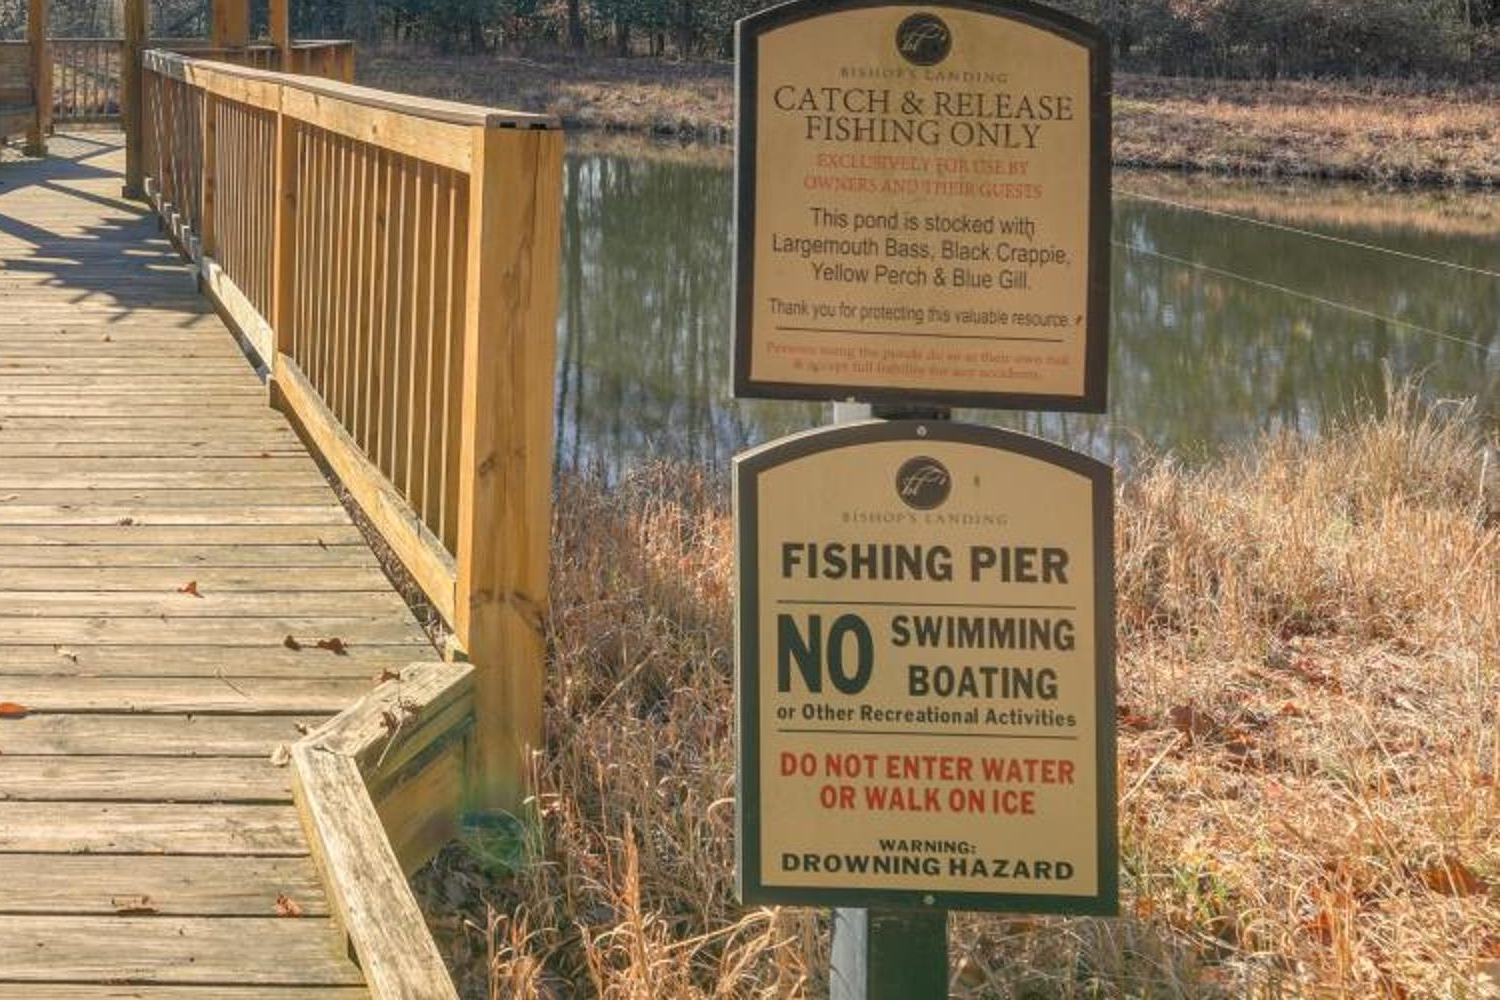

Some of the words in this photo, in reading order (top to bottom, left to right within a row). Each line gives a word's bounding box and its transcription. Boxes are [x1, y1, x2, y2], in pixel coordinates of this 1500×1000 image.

[924, 69, 1009, 83] LANDING
[773, 85, 896, 115] CATCH
[901, 90, 924, 116] &
[934, 91, 1074, 121] RELEASE
[804, 116, 940, 146] FISHING
[950, 122, 1042, 149] ONLY
[818, 153, 930, 172] EXCLUSIVELY
[936, 157, 969, 174] FOR
[973, 159, 1007, 174] USE
[1009, 160, 1029, 175] BY
[803, 175, 877, 194] OWNERS
[881, 179, 919, 195] AND
[923, 180, 975, 197] THEIR
[979, 182, 1043, 200] GUESTS
[810, 207, 848, 229] This
[853, 211, 898, 233] pond
[903, 213, 918, 230] is
[925, 215, 995, 235] stocked
[1000, 217, 1035, 237] with
[772, 233, 879, 258] Largemouth
[885, 238, 935, 260] Bass,
[941, 240, 990, 262] Black
[996, 242, 1072, 268] Crappie,
[811, 262, 869, 283] Yellow
[874, 264, 927, 286] Perch
[932, 268, 946, 287] &
[953, 268, 993, 289] Blue
[999, 269, 1032, 290] Gill.
[770, 298, 808, 317] Thank
[812, 303, 837, 320] you
[839, 302, 856, 319] for
[859, 306, 925, 325] protecting
[927, 307, 950, 323] this
[954, 309, 1008, 326] valuable
[924, 512, 1009, 525] LANDING
[781, 542, 953, 581] FISHING
[970, 546, 1069, 584] PIER
[891, 614, 1076, 651] SWIMMING
[776, 613, 875, 695] NO
[908, 665, 1059, 700] BOATING
[776, 707, 796, 721] or
[802, 703, 853, 722] Other
[860, 704, 979, 725] Recreational
[985, 708, 1077, 728] Activities
[780, 753, 817, 777] DO
[825, 753, 880, 779] NOT
[886, 755, 973, 781] ENTER
[982, 757, 1076, 784] WATER
[819, 785, 856, 810] OR
[864, 787, 941, 812] WALK
[948, 789, 990, 814] ON
[992, 790, 1036, 815] ICE
[879, 839, 977, 855] WARNING:
[781, 853, 941, 877] DROWNING
[948, 858, 1075, 880] HAZARD
